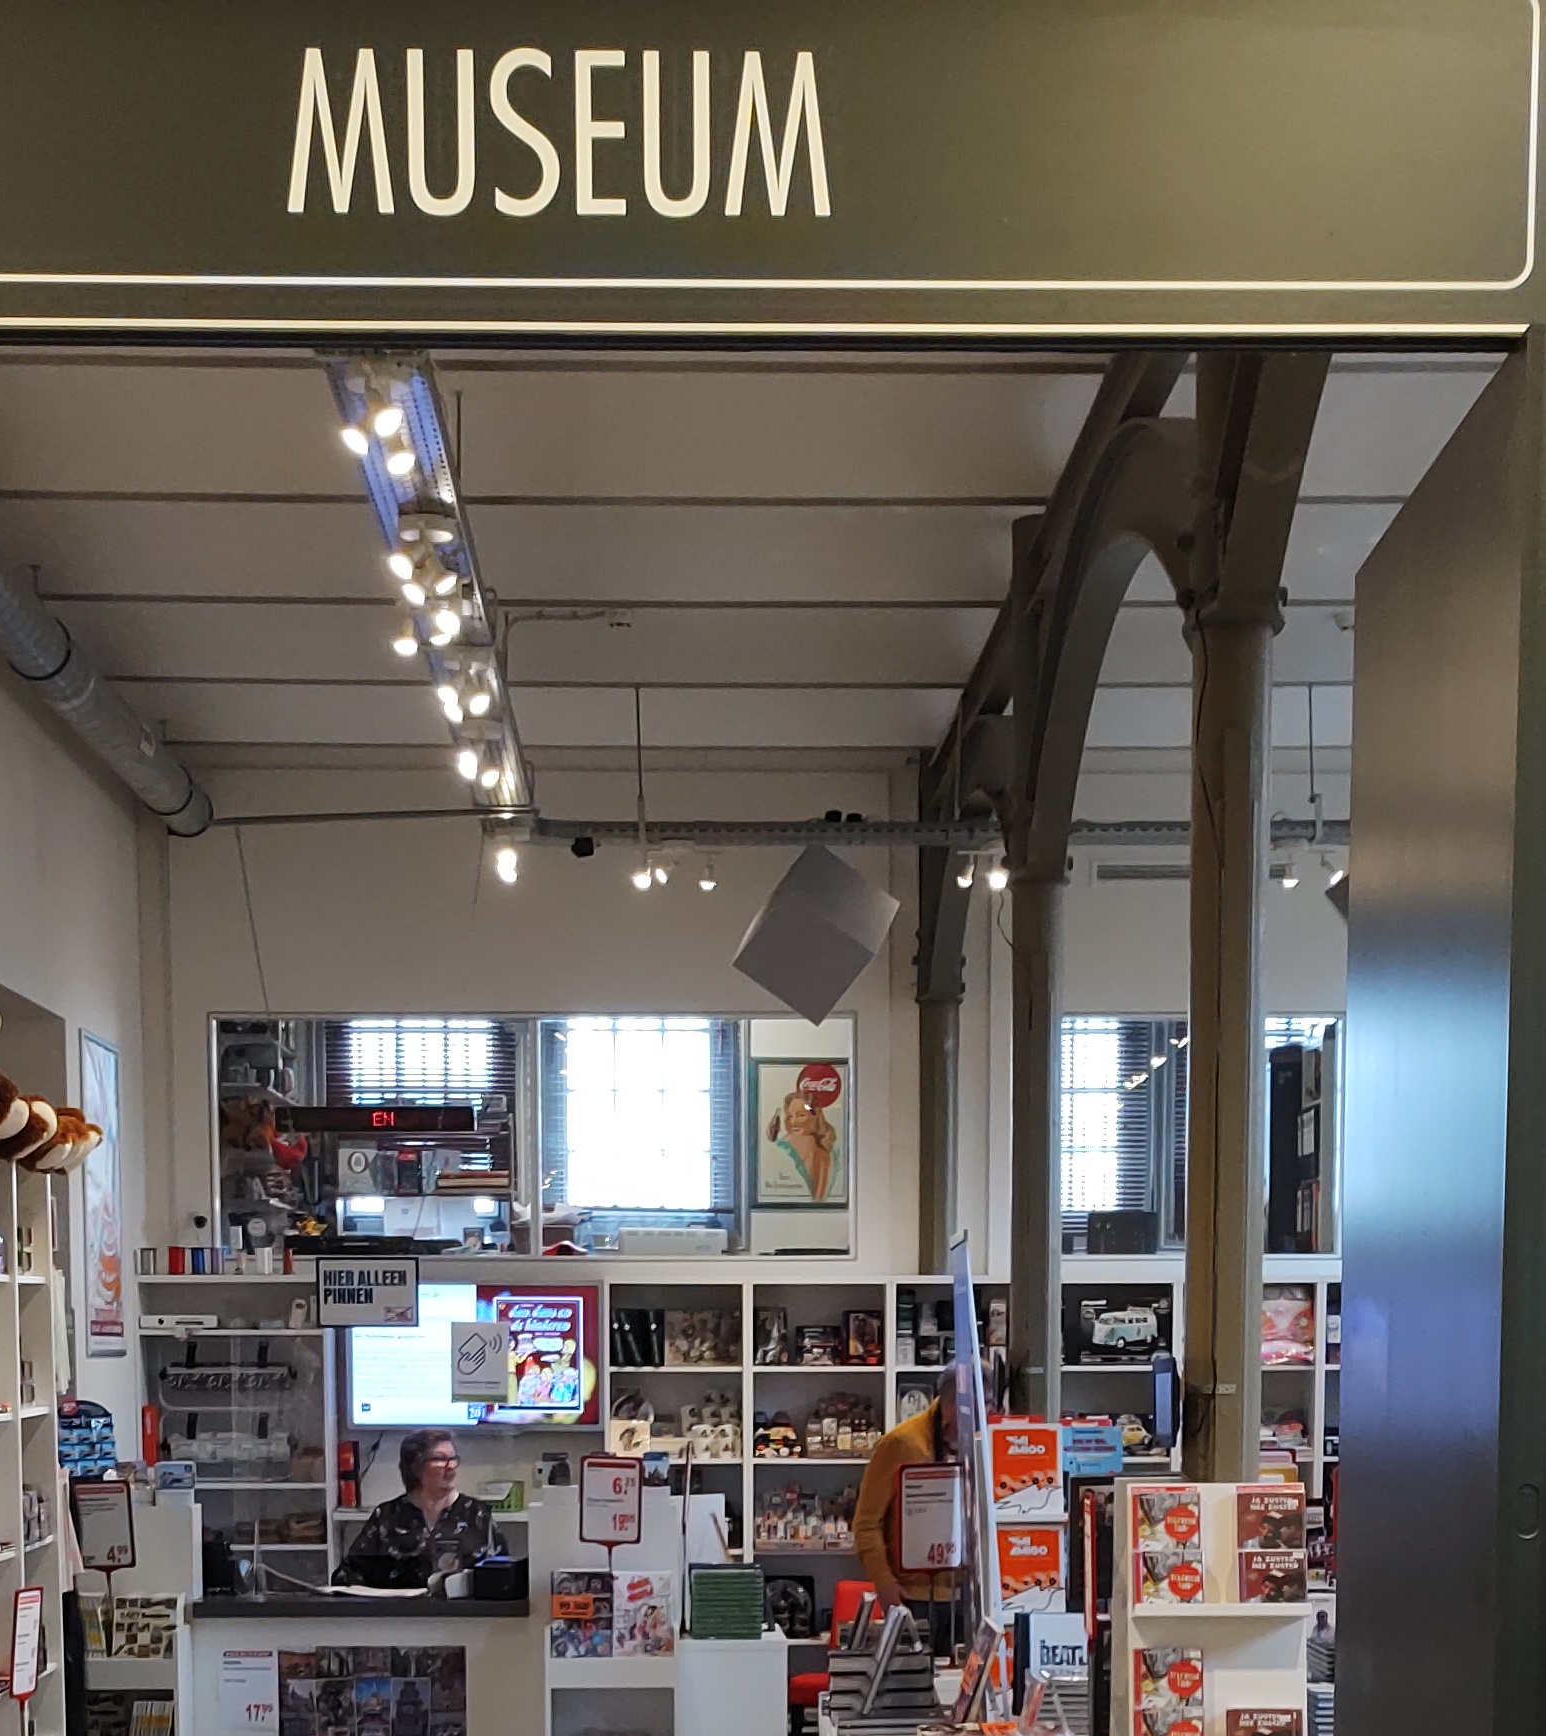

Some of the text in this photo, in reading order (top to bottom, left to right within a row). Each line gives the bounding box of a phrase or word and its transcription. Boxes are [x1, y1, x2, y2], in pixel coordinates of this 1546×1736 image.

[286, 47, 831, 217] MUSEUM
[322, 1269, 407, 1287] HIER ALLEEN
[322, 1288, 374, 1305] PINNEN
